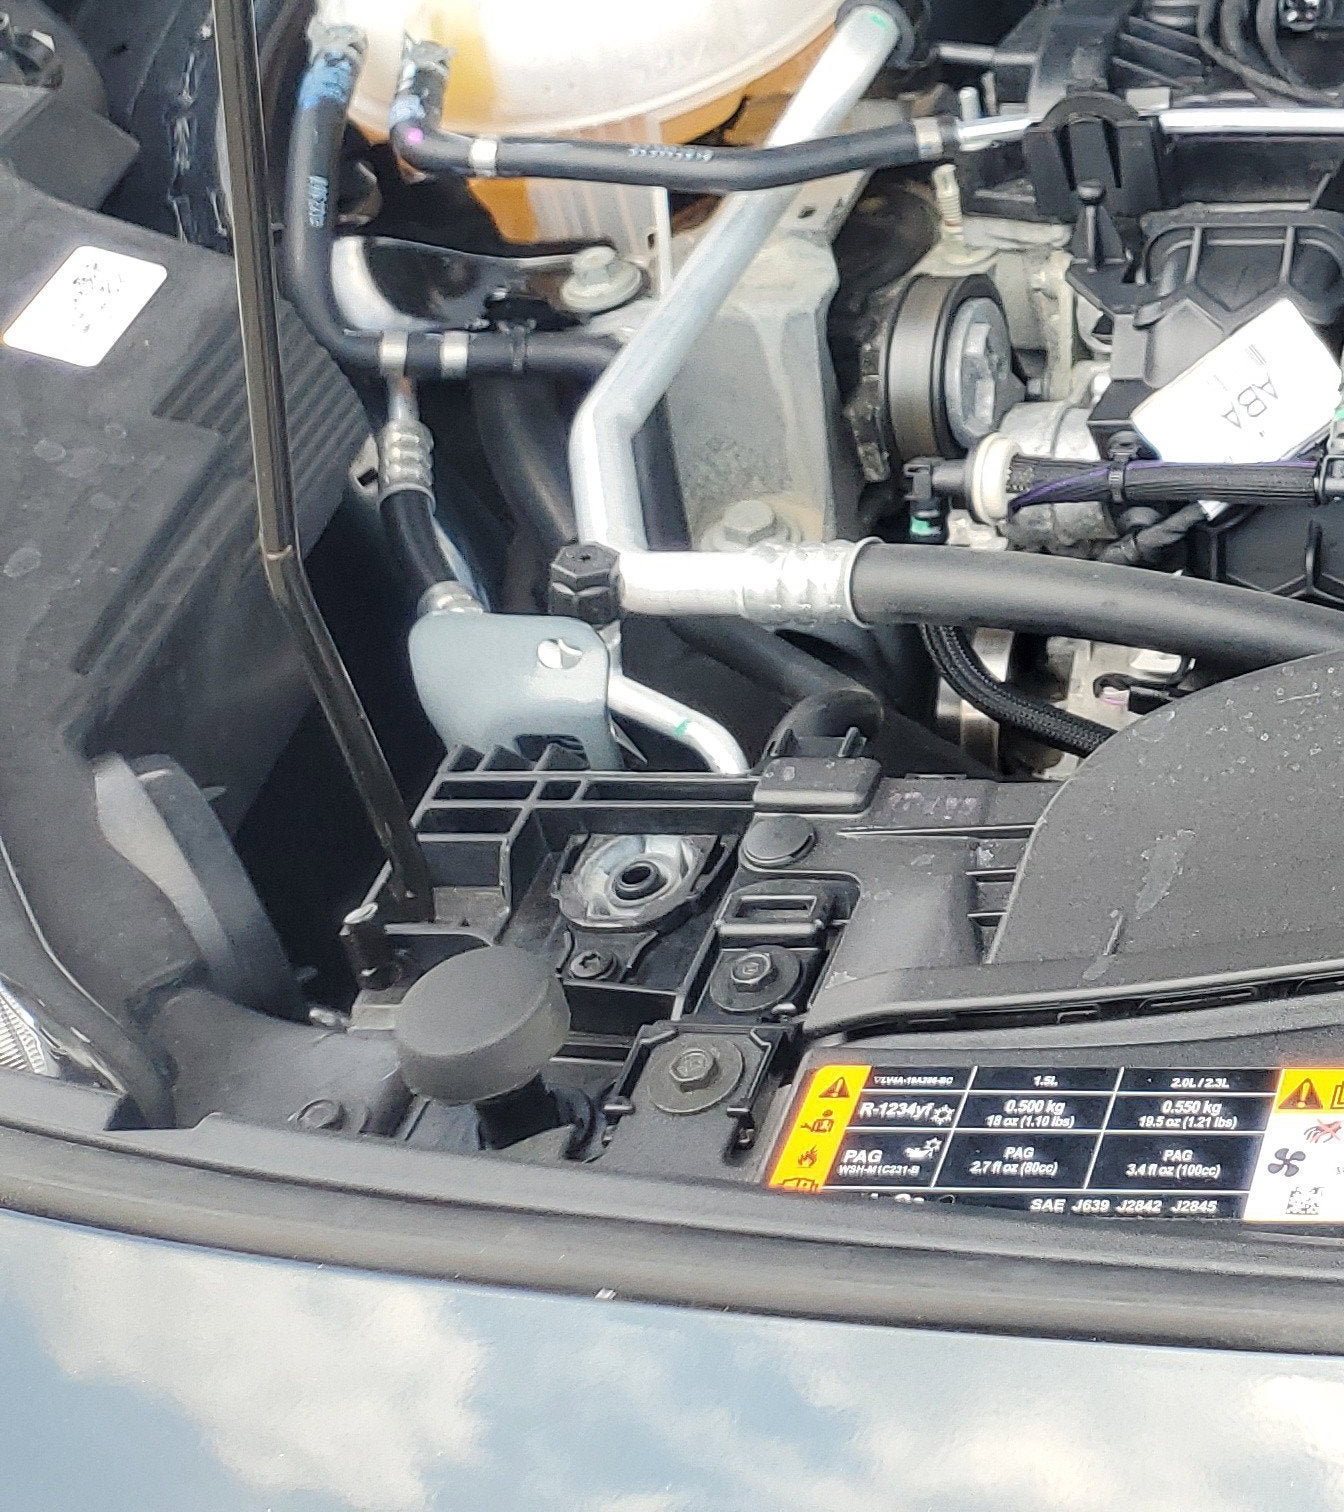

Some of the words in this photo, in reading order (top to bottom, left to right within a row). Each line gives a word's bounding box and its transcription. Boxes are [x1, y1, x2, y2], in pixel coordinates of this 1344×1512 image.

[1220, 371, 1279, 429] ABA
[1204, 1077, 1230, 1088] 2.3L
[859, 1101, 934, 1120] R-1234yf
[1003, 1099, 1045, 1115] 0.500
[1045, 1099, 1066, 1115] kg
[1160, 1099, 1201, 1115] 0.550
[1202, 1099, 1223, 1116] kg
[1002, 1117, 1019, 1128] oz
[1051, 1115, 1076, 1129] lbs)
[1138, 1115, 1165, 1128] 19.5
[1165, 1118, 1182, 1128] oz
[1182, 1116, 1212, 1130] (1.21
[1213, 1116, 1239, 1130] lbs)
[842, 1148, 884, 1164] PAG
[1003, 1146, 1035, 1160] PAG
[1162, 1149, 1194, 1162] PAG
[968, 1160, 992, 1176] 2.7
[991, 1160, 1003, 1175] fl
[1002, 1164, 1019, 1174] oz
[1020, 1161, 1059, 1177] (80cc)
[1125, 1163, 1147, 1177] 3.4
[1146, 1163, 1158, 1176] fl
[1158, 1167, 1175, 1176] oz
[1176, 1163, 1222, 1179] (100cc)
[1030, 1198, 1067, 1214] SAE
[1070, 1199, 1112, 1214] J639
[1115, 1199, 1163, 1214] J2842
[1169, 1199, 1219, 1214] J2845
